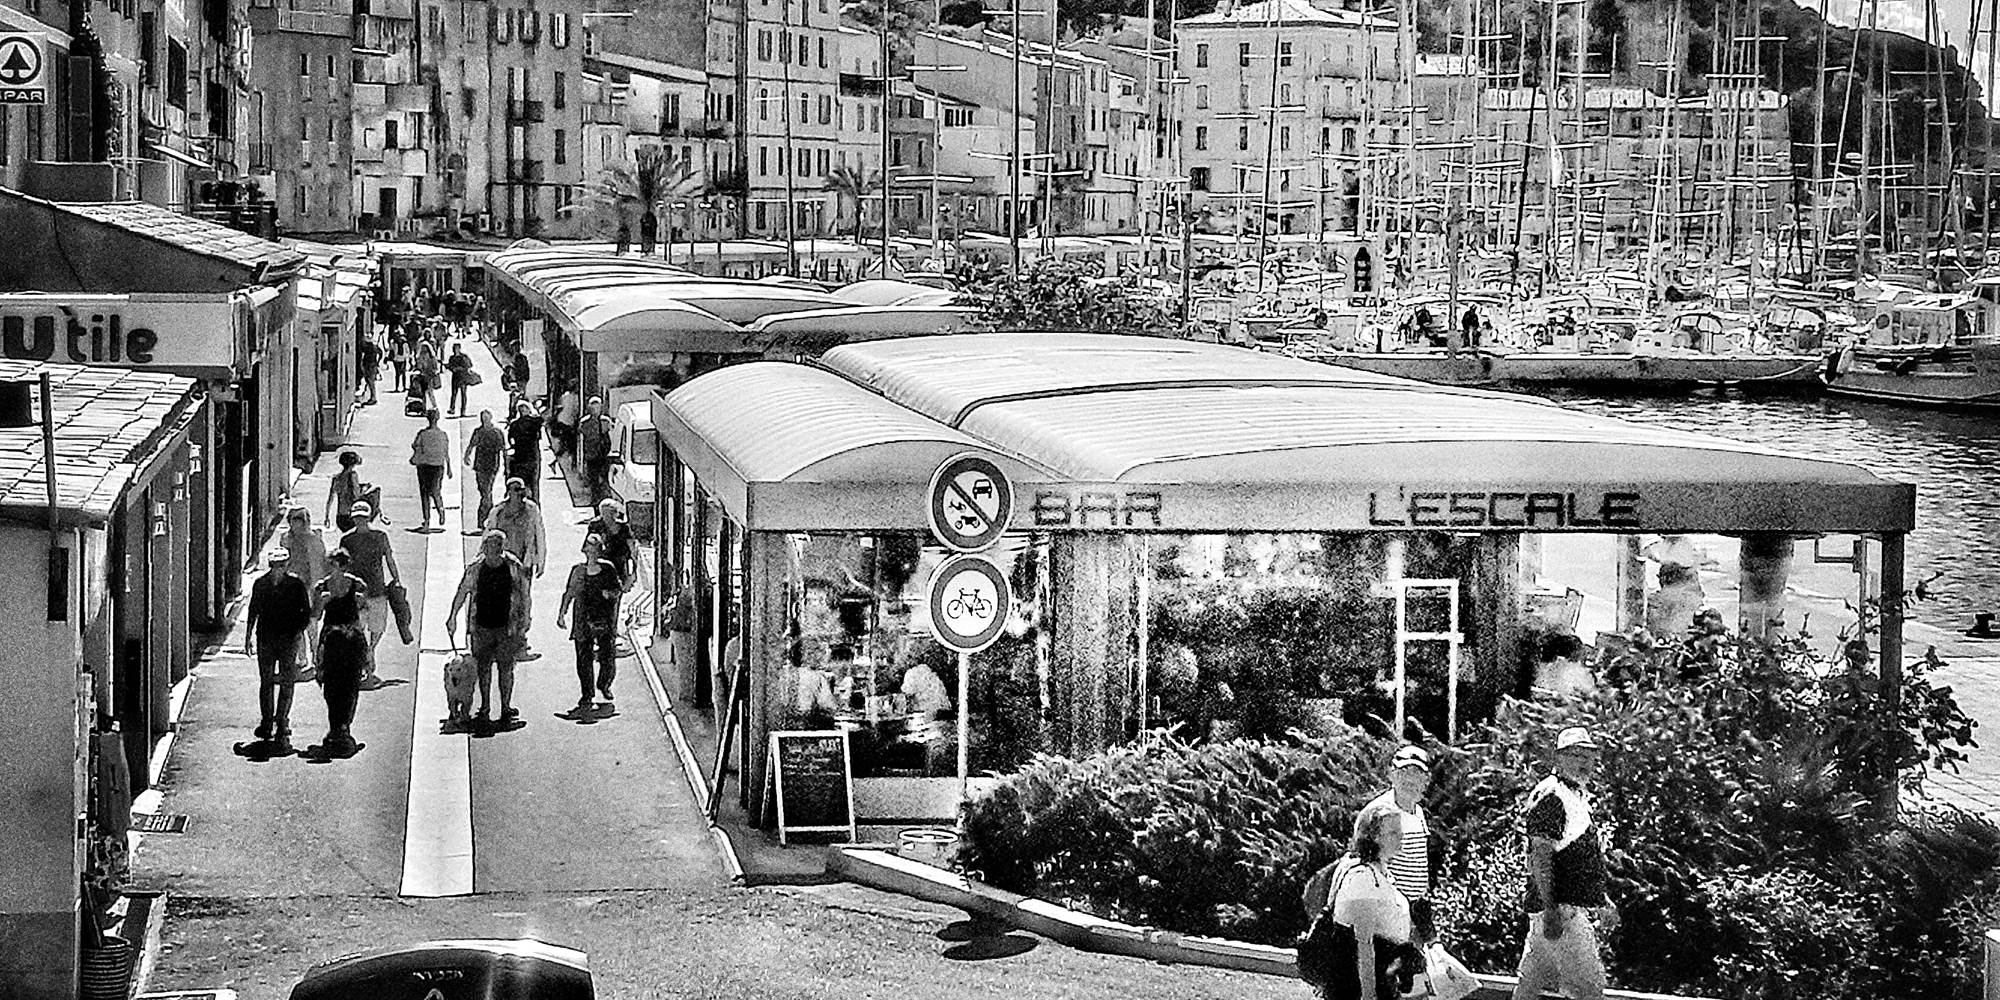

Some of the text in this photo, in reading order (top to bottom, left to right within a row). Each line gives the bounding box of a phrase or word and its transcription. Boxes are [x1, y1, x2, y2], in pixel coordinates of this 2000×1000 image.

[0, 90, 43, 101] PAR
[1031, 485, 1640, 527] BAR L'ESCALE
